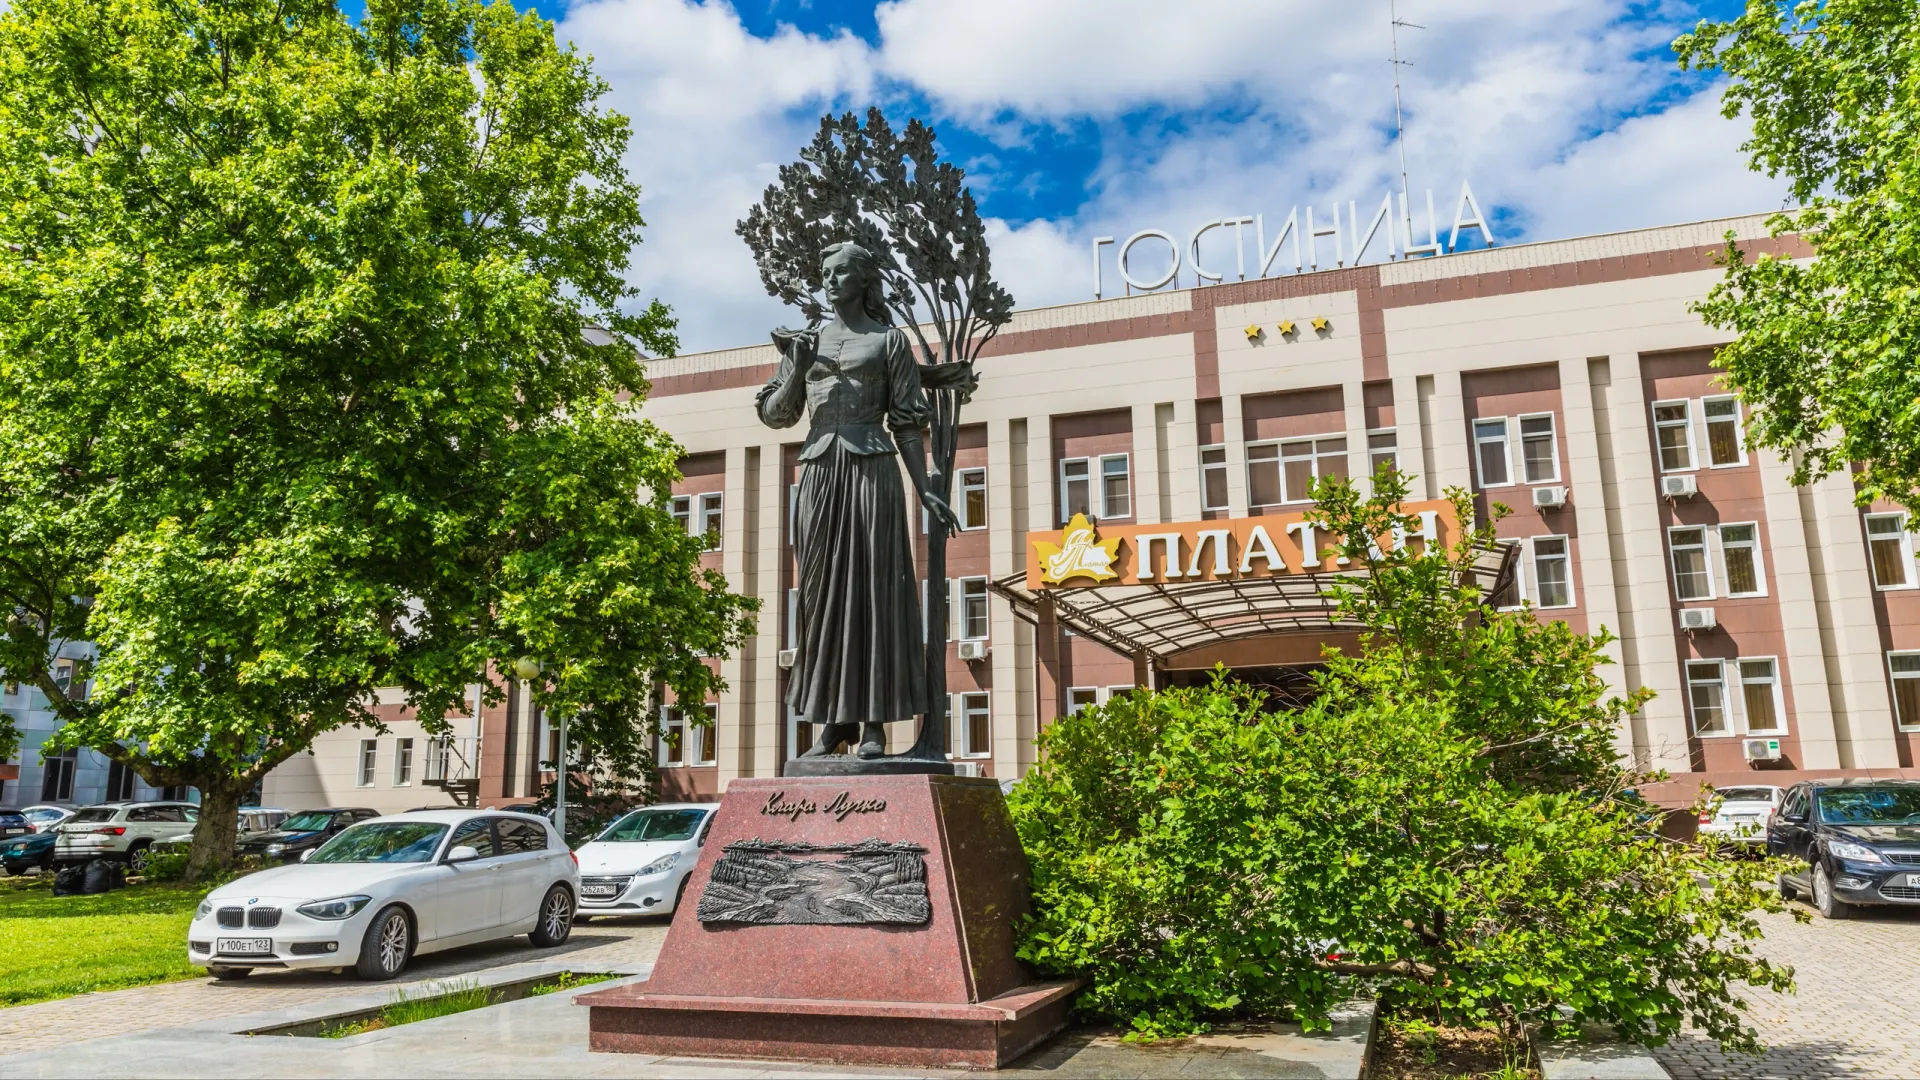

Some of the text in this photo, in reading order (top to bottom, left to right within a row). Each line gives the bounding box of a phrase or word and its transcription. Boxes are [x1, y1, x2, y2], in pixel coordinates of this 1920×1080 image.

[1093, 179, 1494, 295] ГОСТИНИЦА
[761, 791, 887, 822] Клара Лучко
[220, 940, 268, 951] У100ЕТ 123
